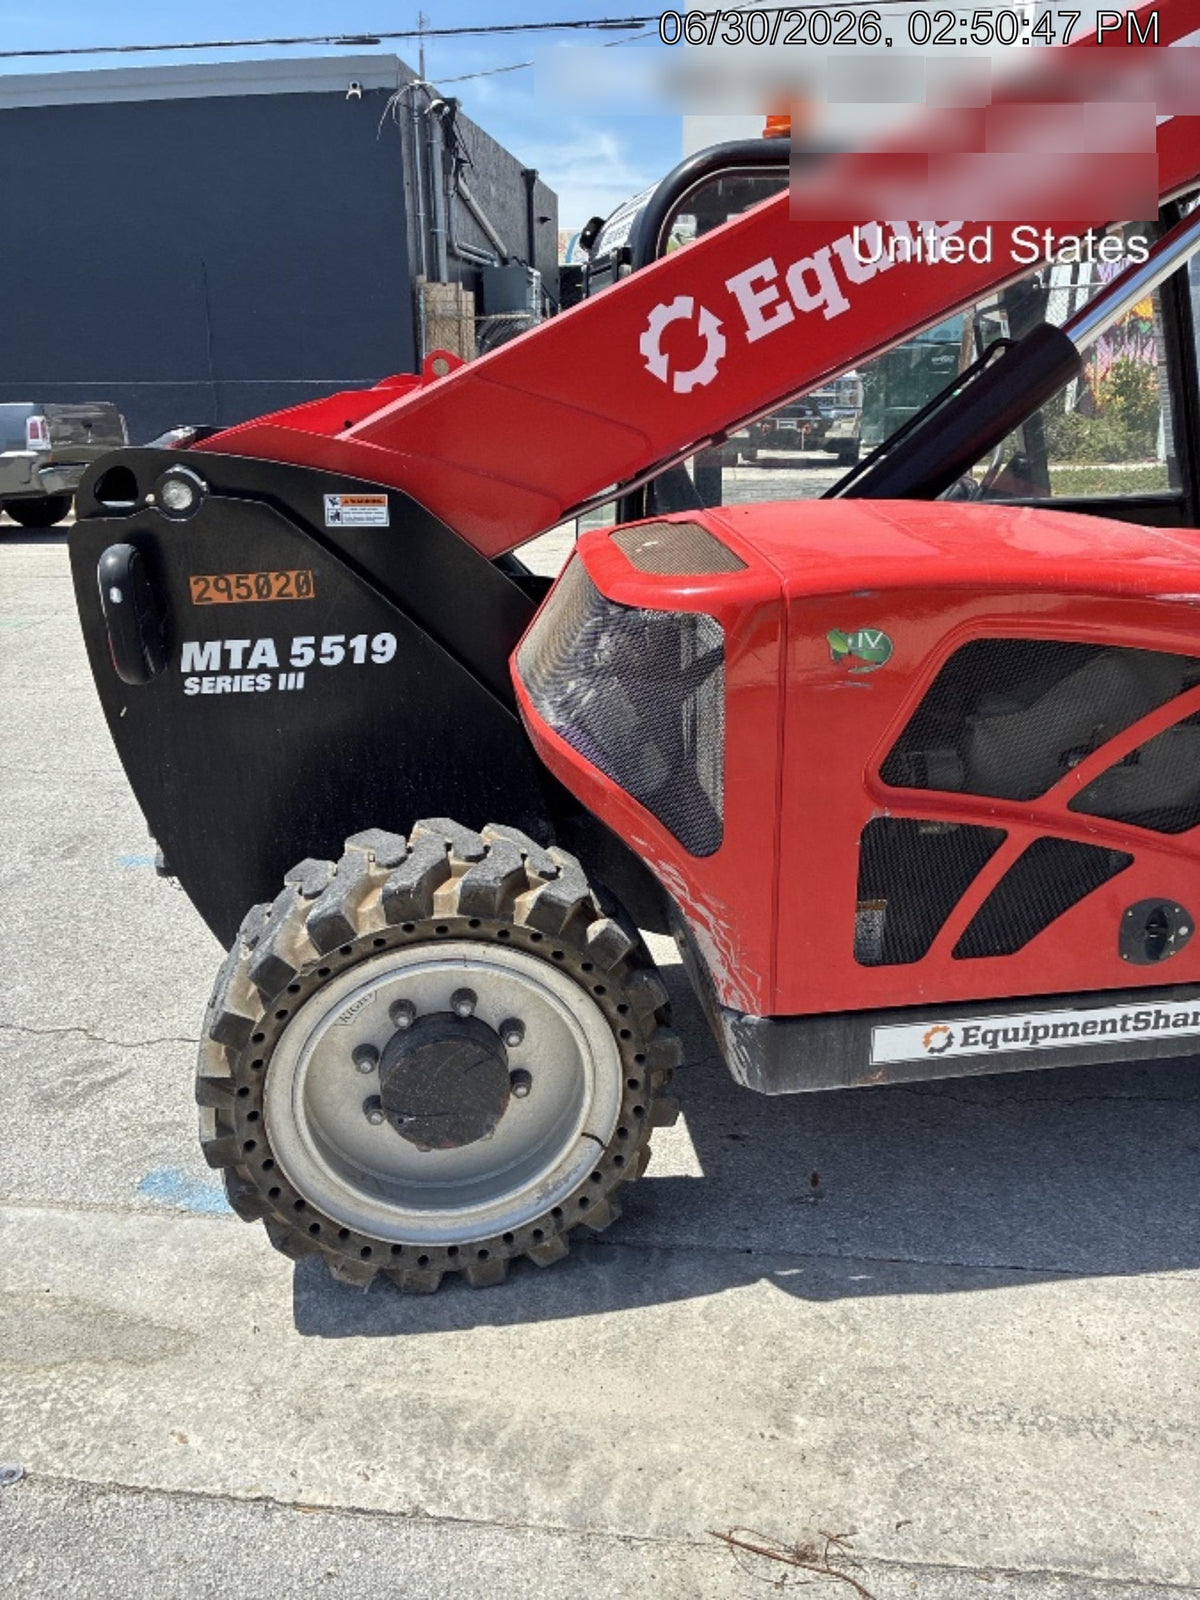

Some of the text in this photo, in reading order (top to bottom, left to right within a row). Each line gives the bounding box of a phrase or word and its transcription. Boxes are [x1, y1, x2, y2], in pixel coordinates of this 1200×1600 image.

[193, 572, 312, 602] 295020
[180, 632, 398, 673] MTA 5519
[184, 672, 306, 696] SERIES III
